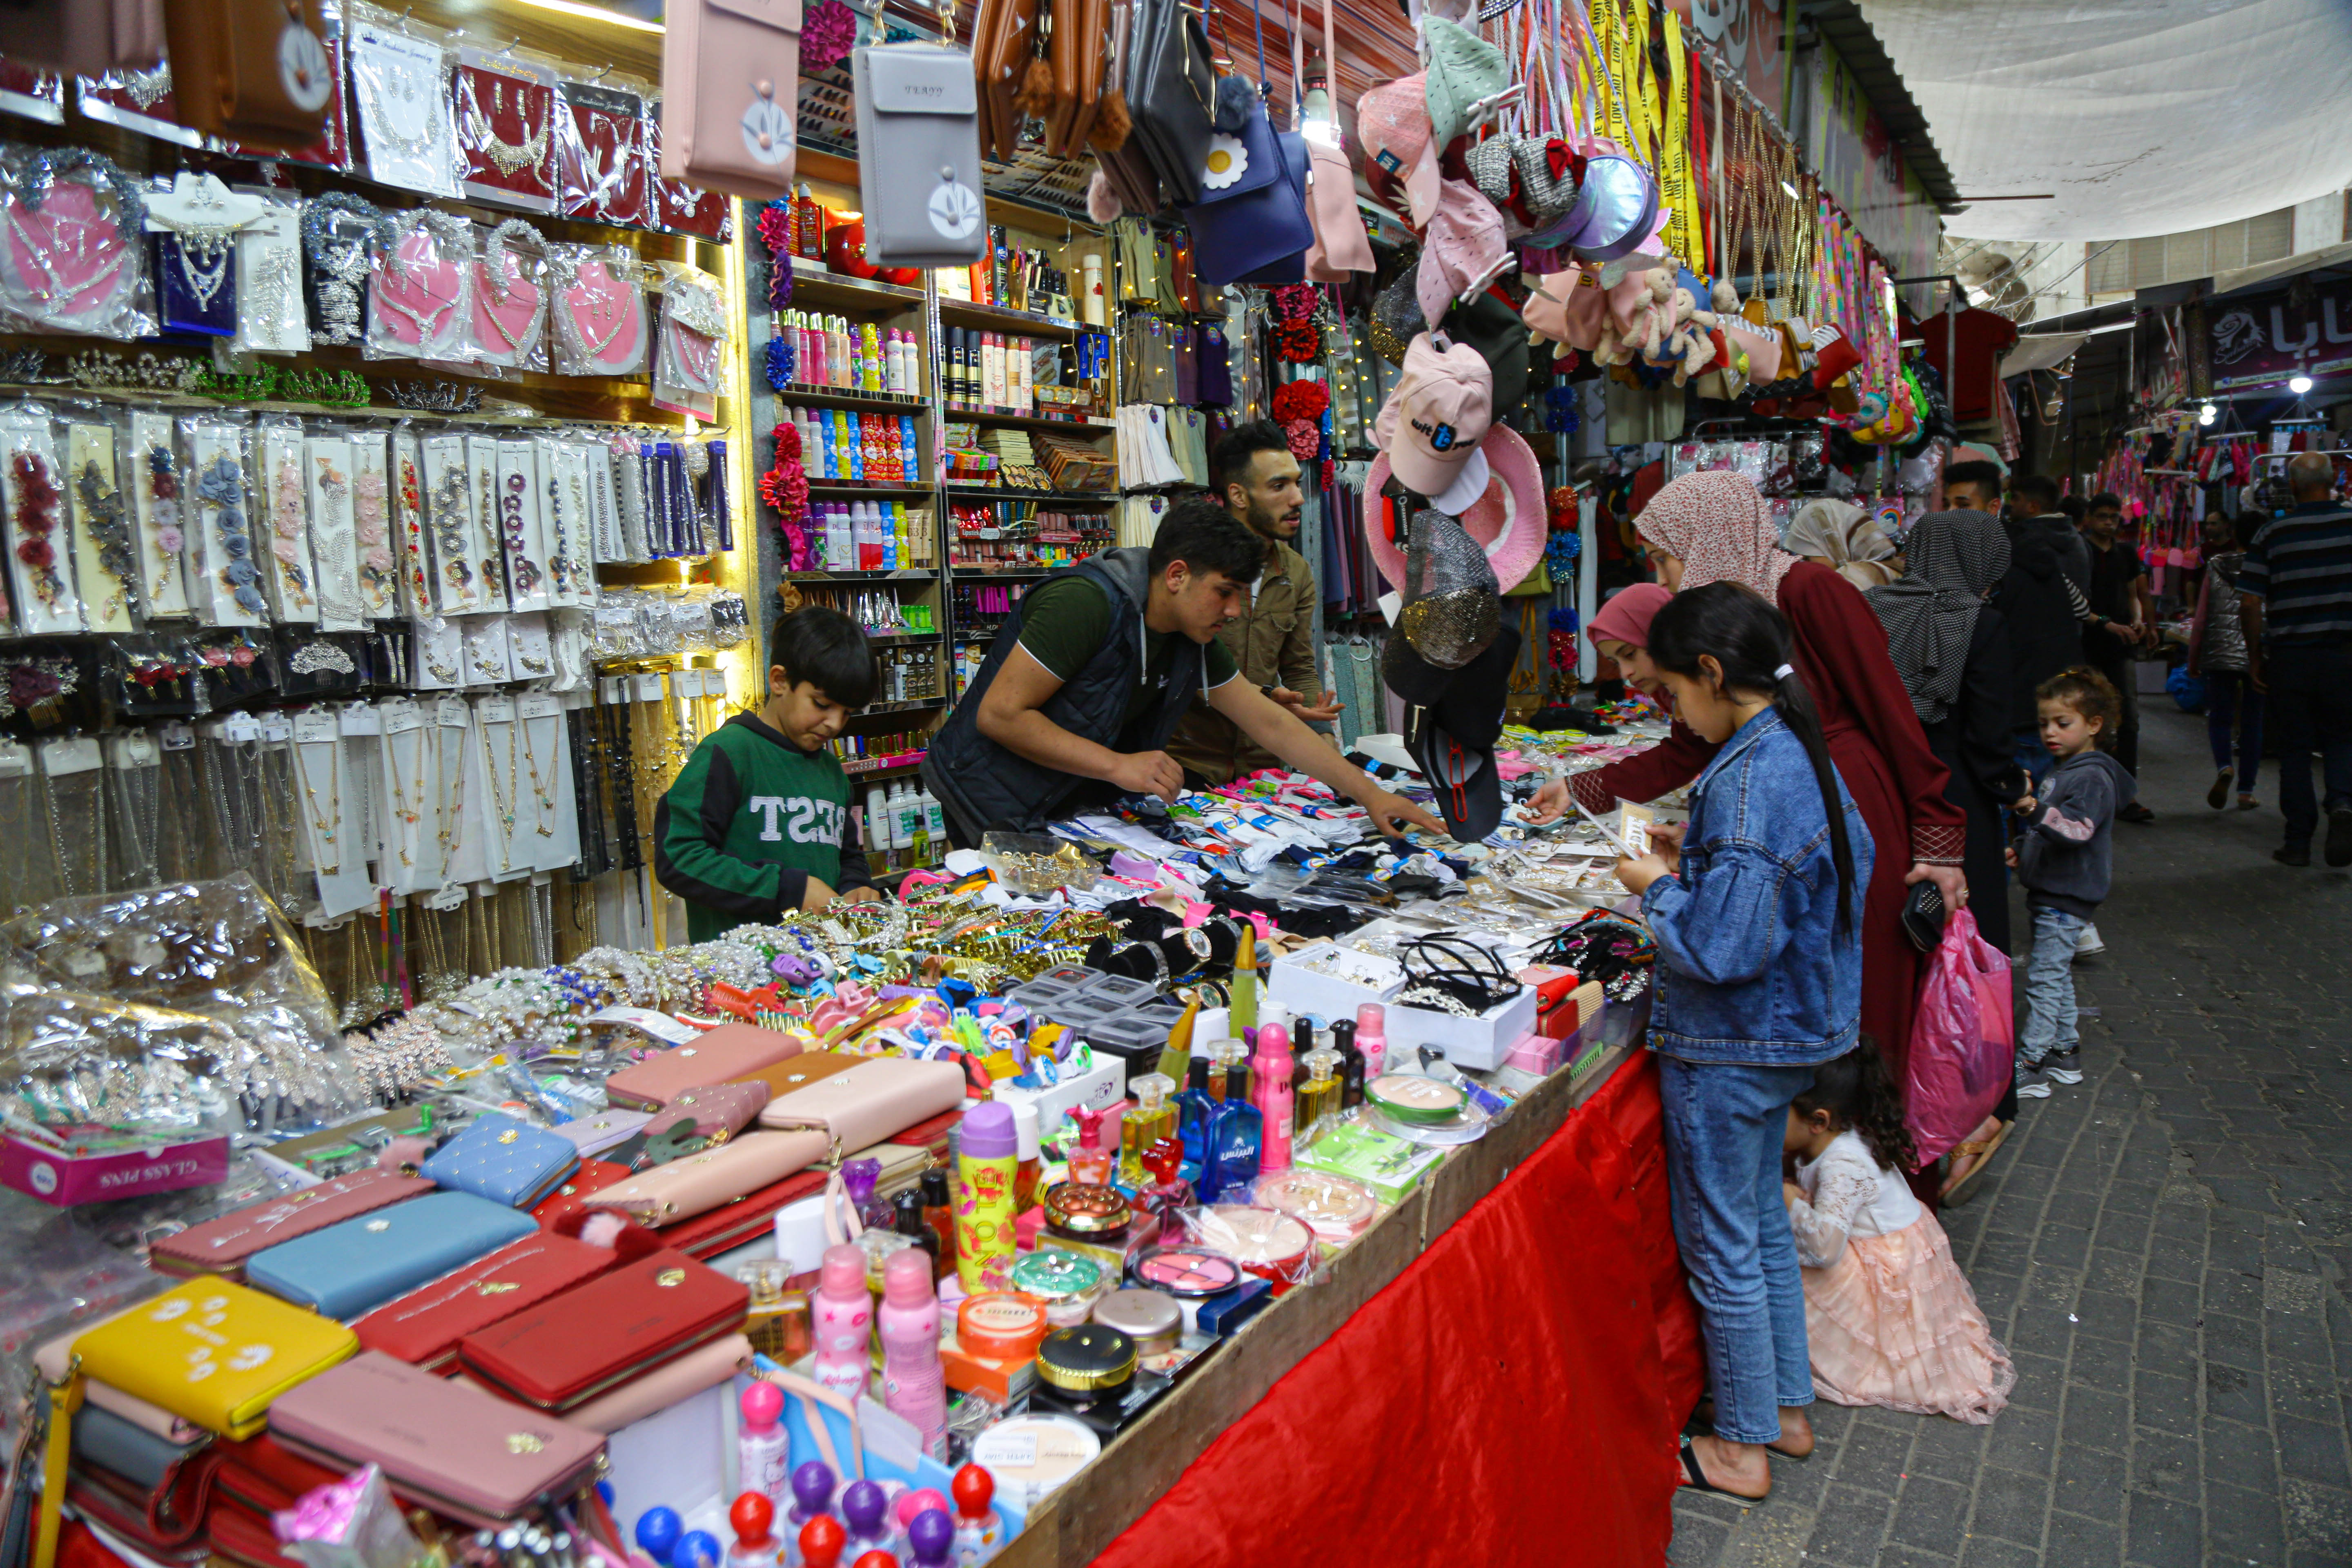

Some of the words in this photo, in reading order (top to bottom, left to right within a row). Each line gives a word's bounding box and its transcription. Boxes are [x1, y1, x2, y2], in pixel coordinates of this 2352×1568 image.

[1613, 41, 1621, 63] LOVE
[576, 95, 604, 107] Fashion
[604, 101, 631, 113] Jewelry
[1220, 1145, 1255, 1161] البرنس
[144, 1160, 198, 1180] GLASS
[975, 1174, 997, 1267] NOTE
